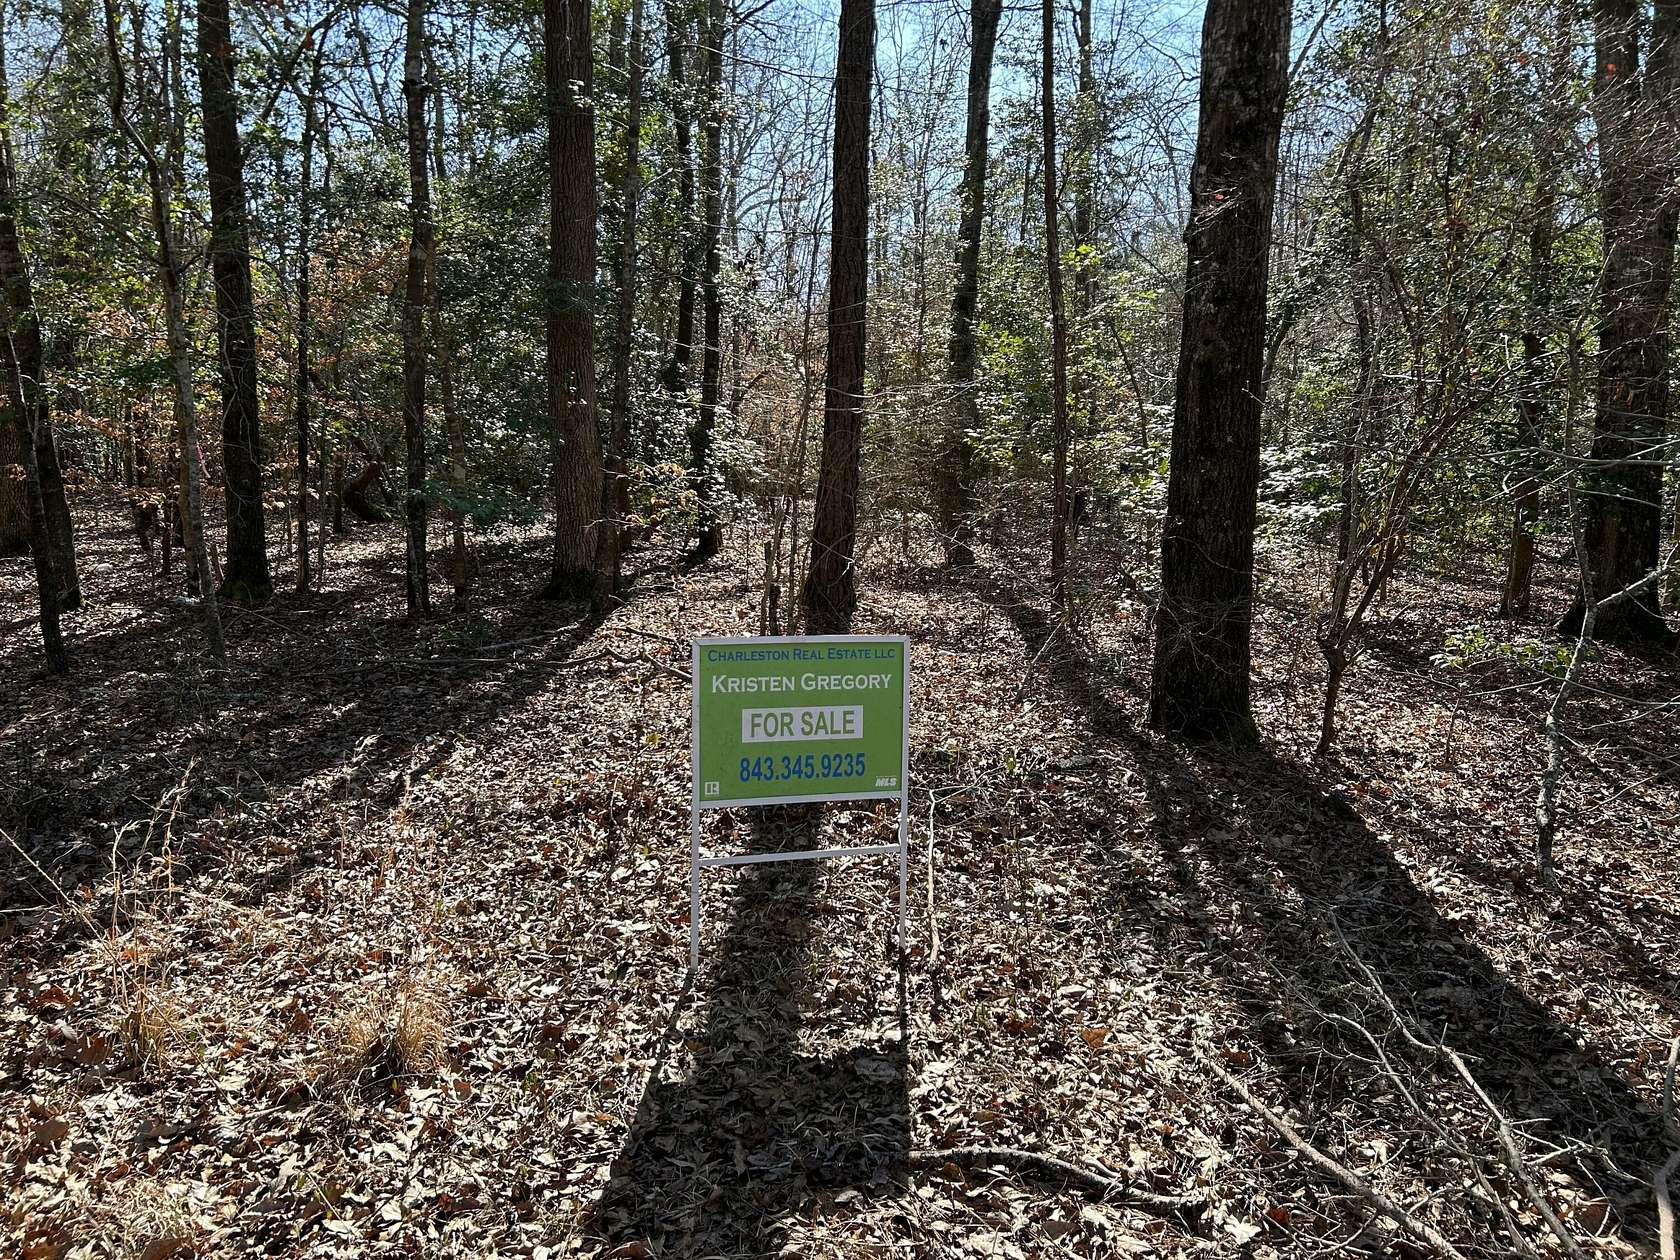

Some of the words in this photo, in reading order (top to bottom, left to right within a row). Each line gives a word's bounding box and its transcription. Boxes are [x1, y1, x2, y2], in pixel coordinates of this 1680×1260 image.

[874, 648, 896, 659] LLC
[750, 712, 794, 738] FOR
[800, 710, 855, 736] SALE
[739, 753, 866, 782] 843.345.9235
[875, 777, 897, 787] MLS
